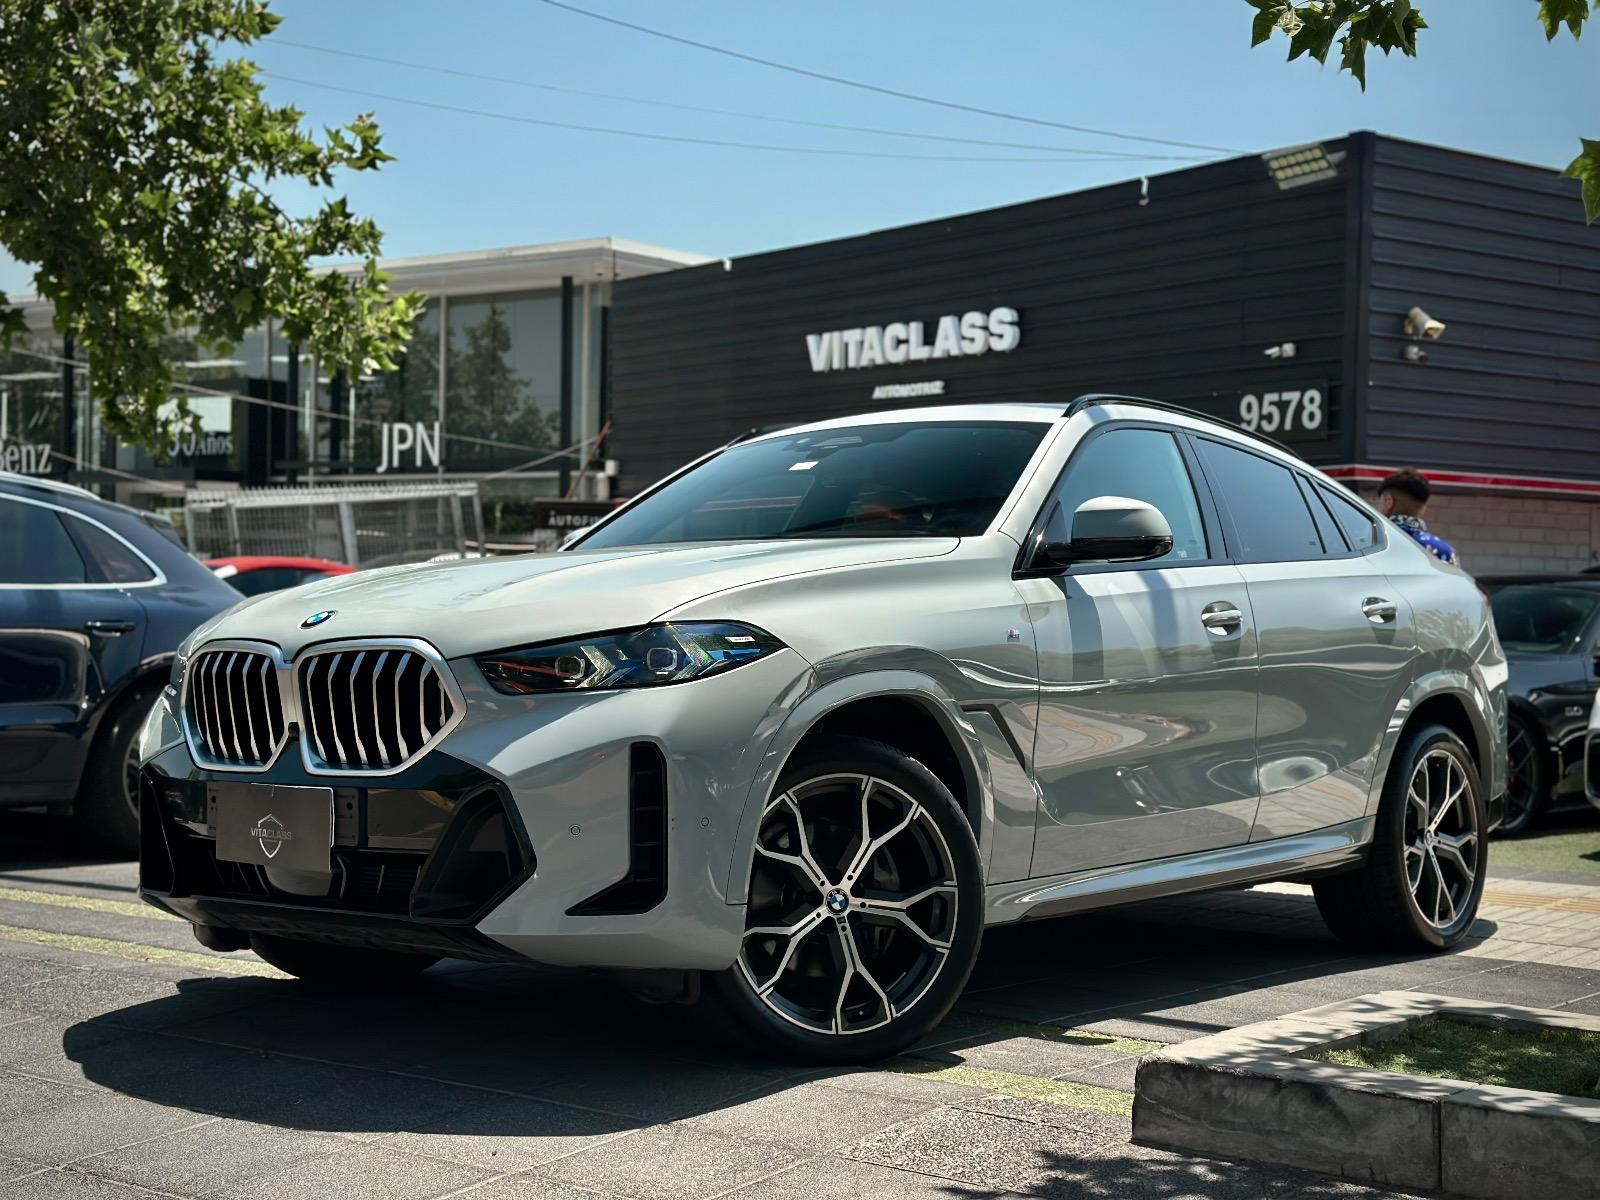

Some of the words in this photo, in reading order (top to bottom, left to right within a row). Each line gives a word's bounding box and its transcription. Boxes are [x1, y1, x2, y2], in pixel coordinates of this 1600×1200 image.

[806, 307, 1020, 372] VITACLASS
[1240, 388, 1322, 433] 9578
[194, 431, 234, 456] Años
[376, 421, 440, 473] JPN
